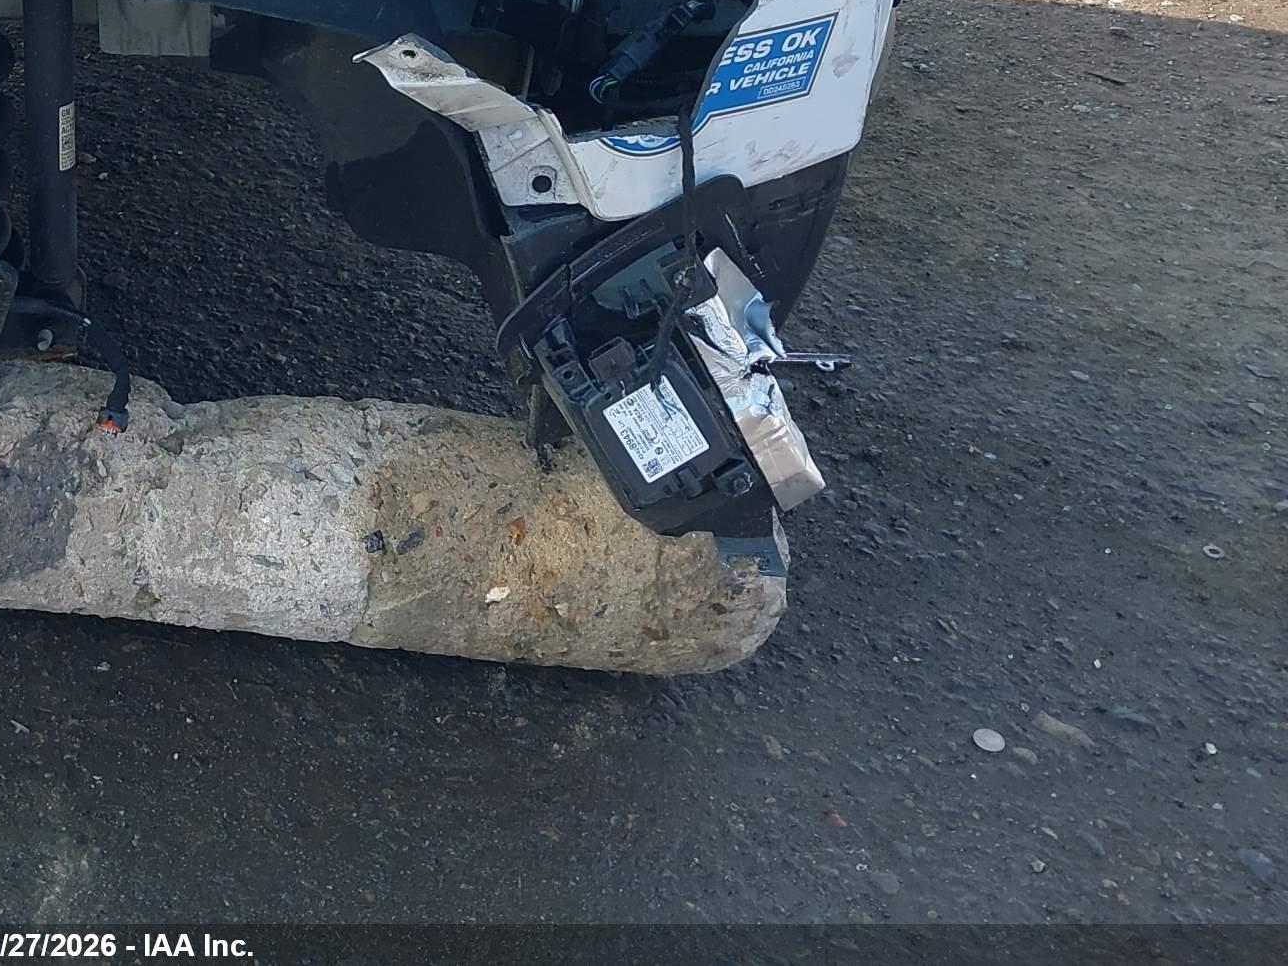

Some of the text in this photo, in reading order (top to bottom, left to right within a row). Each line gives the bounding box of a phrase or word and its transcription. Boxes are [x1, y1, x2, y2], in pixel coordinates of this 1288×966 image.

[782, 26, 824, 52] OK
[743, 49, 814, 74] CALIFORNIA
[729, 61, 811, 91] VEHICLE
